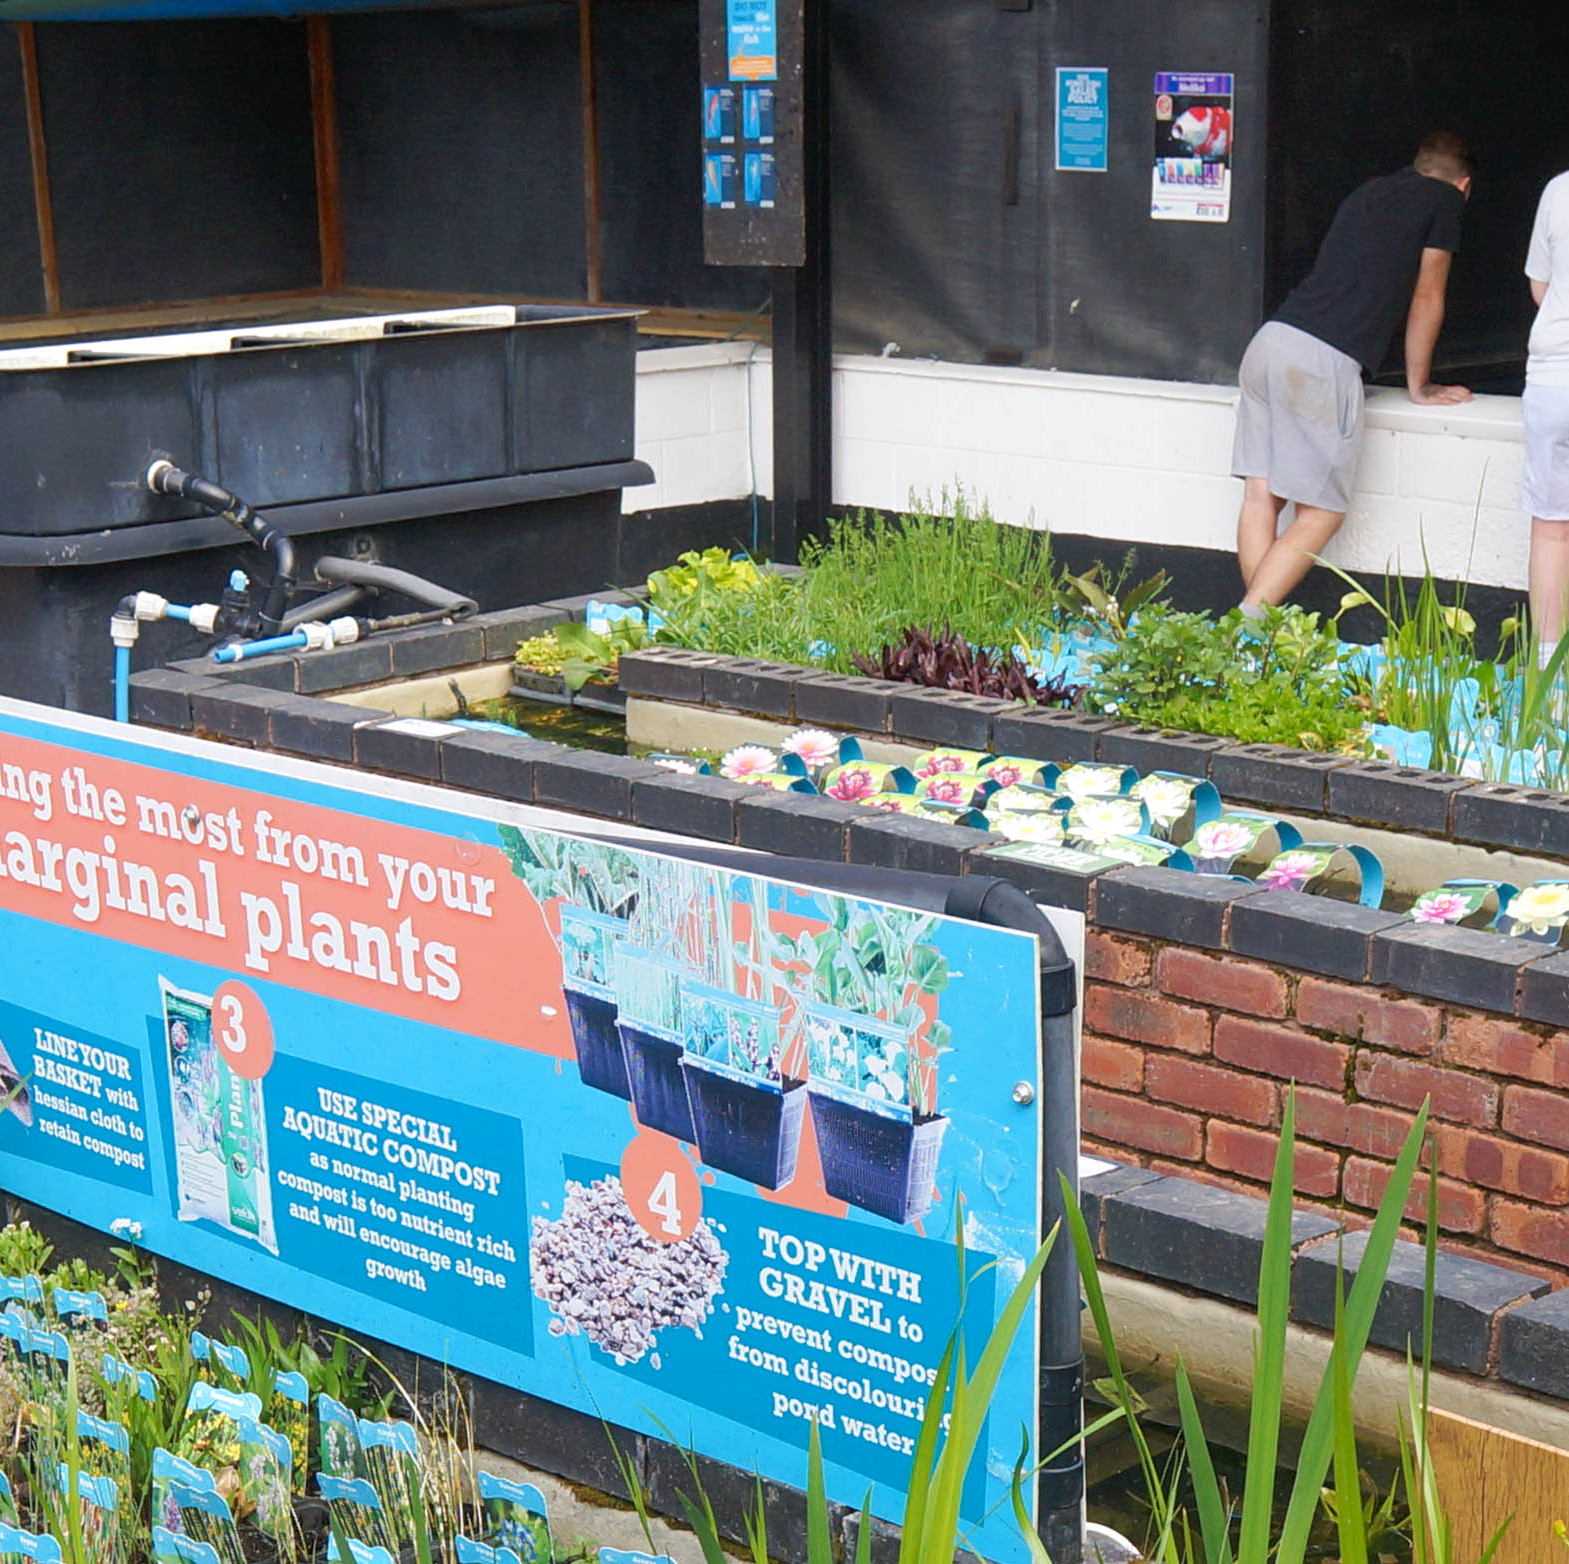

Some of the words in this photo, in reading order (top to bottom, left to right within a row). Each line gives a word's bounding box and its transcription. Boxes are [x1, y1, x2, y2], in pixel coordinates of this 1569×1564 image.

[60, 766, 127, 827] the
[136, 793, 245, 857] most
[254, 811, 369, 888] from
[377, 850, 496, 919] your
[241, 881, 463, 1003] plants
[33, 1027, 79, 1064] LINE
[77, 1045, 132, 1081] YOUR
[220, 994, 248, 1053] 3
[32, 1055, 102, 1099] BASKET
[105, 1087, 140, 1113] with
[33, 1085, 89, 1121] hessian
[90, 1107, 128, 1136] cloth
[128, 1122, 145, 1142] to
[317, 1086, 359, 1122] USE
[361, 1101, 458, 1153] SPECIAL
[38, 1117, 82, 1147] retain
[83, 1135, 146, 1171] compost
[282, 1105, 379, 1157] AQUATIC
[382, 1138, 502, 1196] COMPOST
[277, 1169, 348, 1207] compost
[350, 1189, 368, 1212] is
[369, 1197, 398, 1223] too
[399, 1210, 474, 1249] nutrient
[476, 1234, 517, 1263] rich
[309, 1151, 330, 1171] as
[332, 1158, 396, 1193] normal
[399, 1178, 476, 1224] planting
[647, 1171, 682, 1237] 4
[289, 1202, 322, 1226] and
[323, 1212, 357, 1239] will
[359, 1226, 452, 1272] encourage
[455, 1257, 507, 1289] algae
[365, 1257, 428, 1292] growth
[757, 1226, 826, 1273] TOP
[828, 1246, 923, 1305] WITH
[759, 1267, 892, 1334] GRAVEL
[897, 1314, 925, 1343] to
[734, 1305, 832, 1353] prevent
[837, 1339, 950, 1393] compos
[728, 1335, 790, 1377] from
[793, 1357, 955, 1438] discolourig
[772, 1391, 836, 1430] pond
[840, 1414, 916, 1456] water
